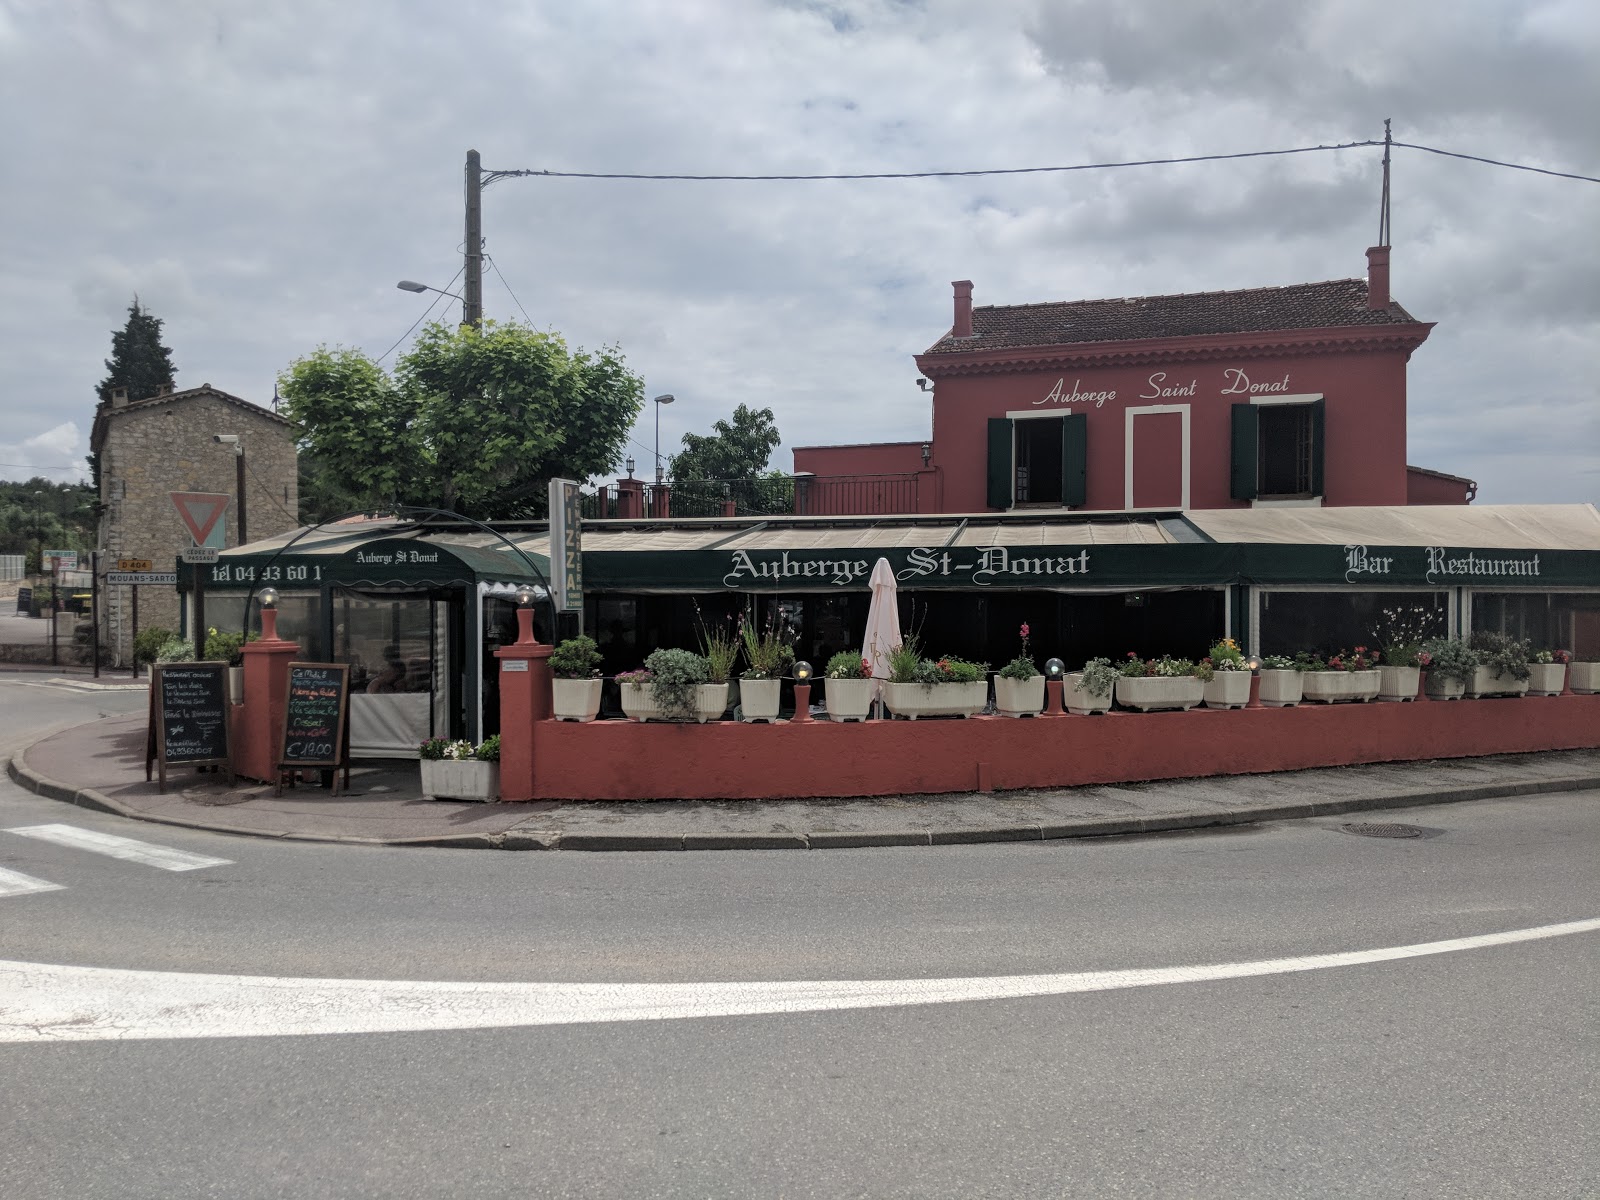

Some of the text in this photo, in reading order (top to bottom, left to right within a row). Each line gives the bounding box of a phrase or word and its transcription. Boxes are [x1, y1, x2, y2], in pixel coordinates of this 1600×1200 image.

[1032, 367, 1291, 408] Auberge Saint Donat
[564, 484, 576, 591] PIZZA
[211, 564, 231, 582] tél
[235, 566, 256, 581] 04
[286, 566, 308, 581] 60
[356, 551, 439, 565] Auberge St Donat
[722, 549, 869, 588] Auberge
[1343, 544, 1539, 584] Bar Restaurant
